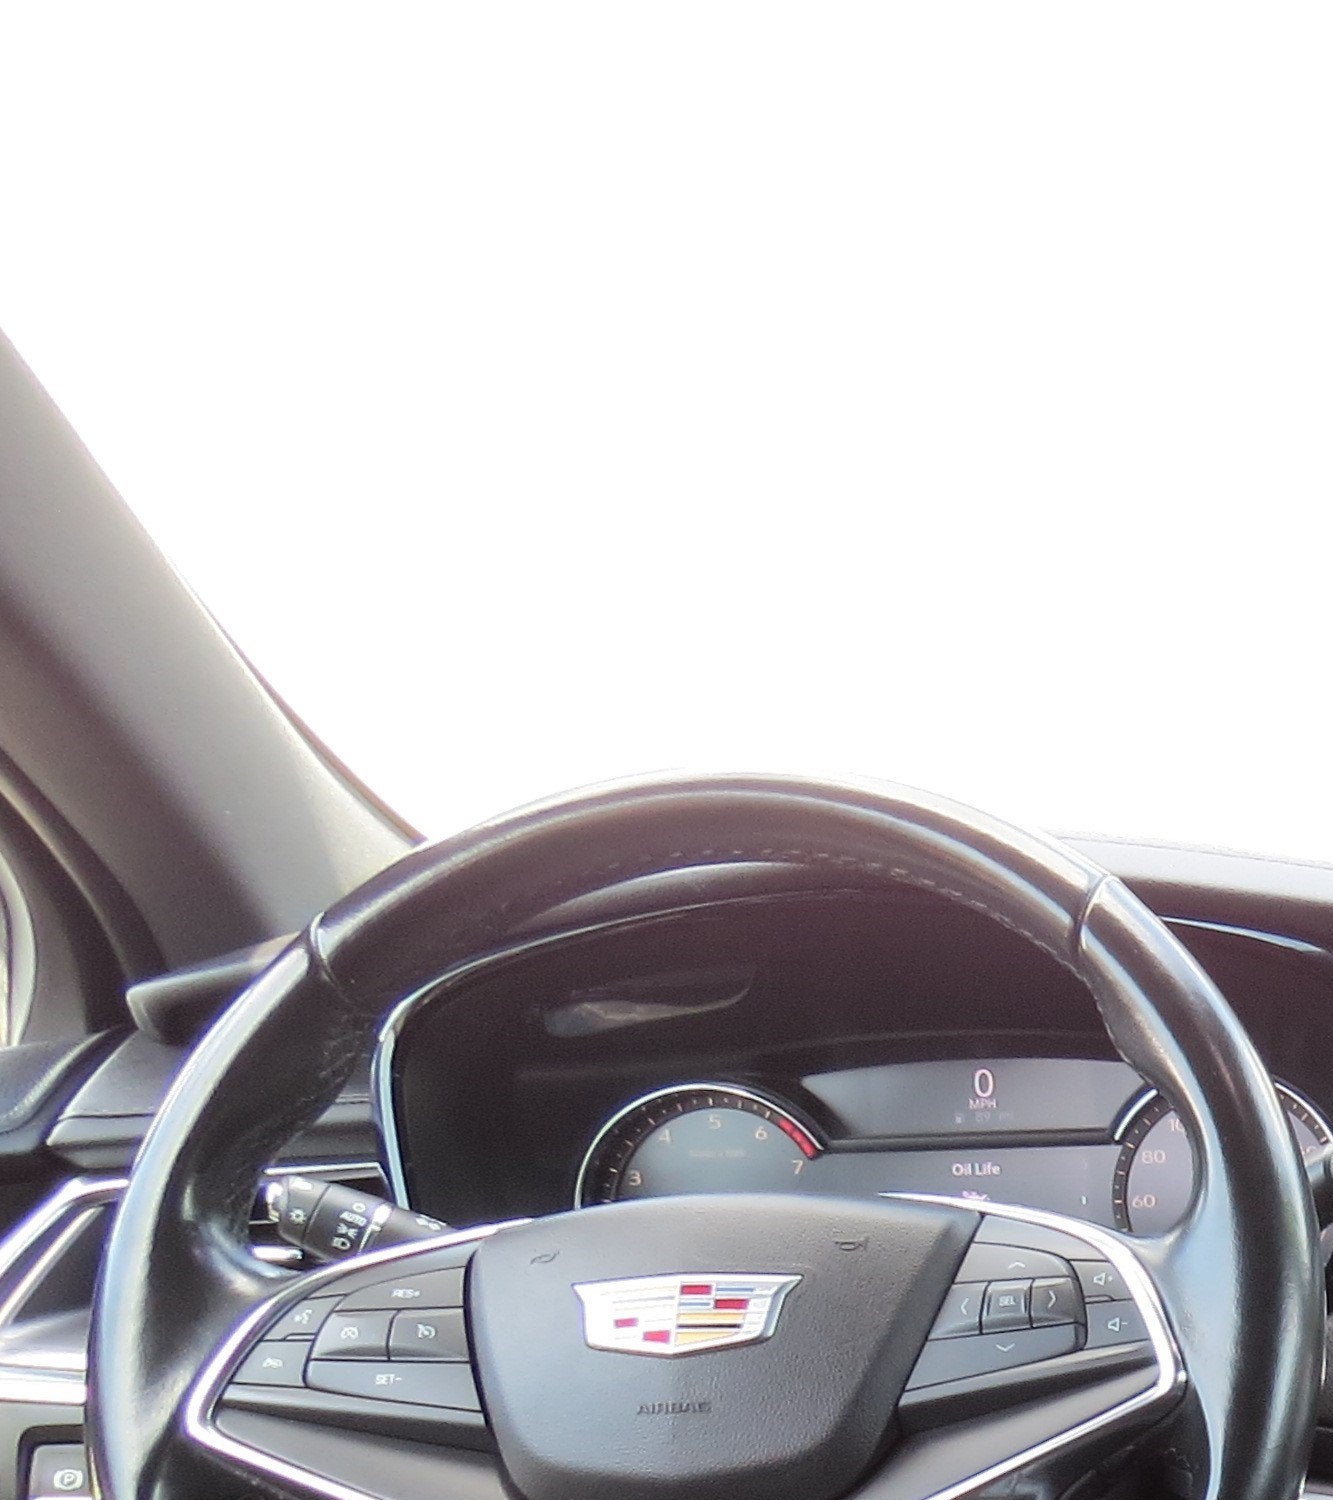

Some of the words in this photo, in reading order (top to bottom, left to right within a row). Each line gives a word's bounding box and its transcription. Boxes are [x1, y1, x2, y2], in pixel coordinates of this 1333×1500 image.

[974, 1068, 994, 1098] 0
[968, 1098, 997, 1109] MPH
[709, 1114, 722, 1130] 5
[658, 1128, 672, 1145] 4
[755, 1124, 768, 1140] 6
[1141, 1150, 1166, 1164] 80
[792, 1159, 803, 1175] 7
[952, 1163, 972, 1176] Oil
[975, 1163, 1001, 1176] Life
[628, 1170, 642, 1186] 3
[1132, 1196, 1156, 1208] 60
